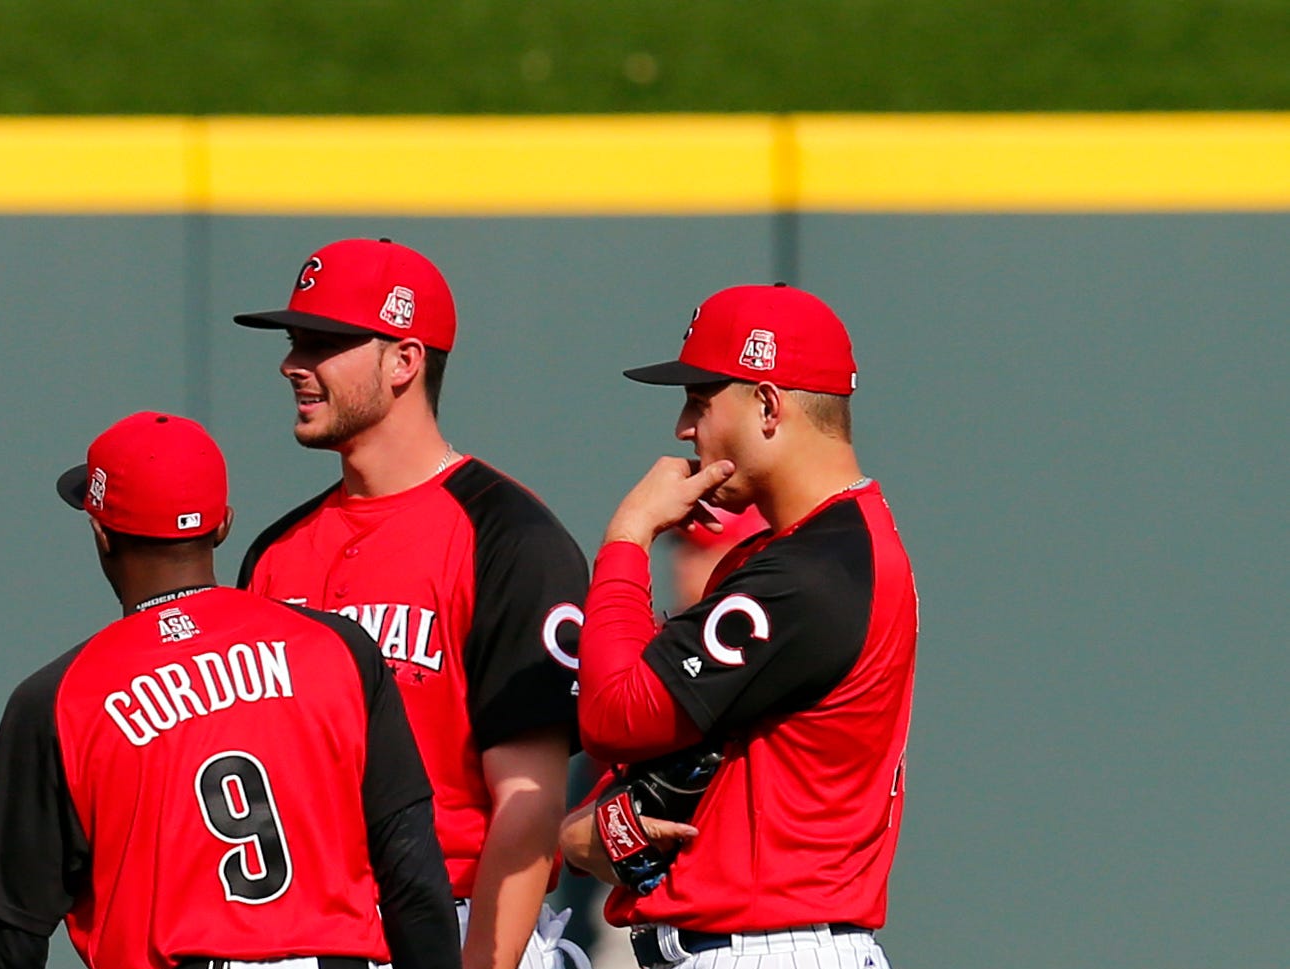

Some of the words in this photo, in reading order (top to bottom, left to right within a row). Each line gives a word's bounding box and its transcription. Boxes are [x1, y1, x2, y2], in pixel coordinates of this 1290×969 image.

[386, 295, 413, 319] ASG
[745, 340, 774, 361] ASG
[158, 615, 195, 636] ASG
[703, 592, 771, 666] C
[104, 641, 294, 746] GORDON
[194, 750, 293, 905] 9
